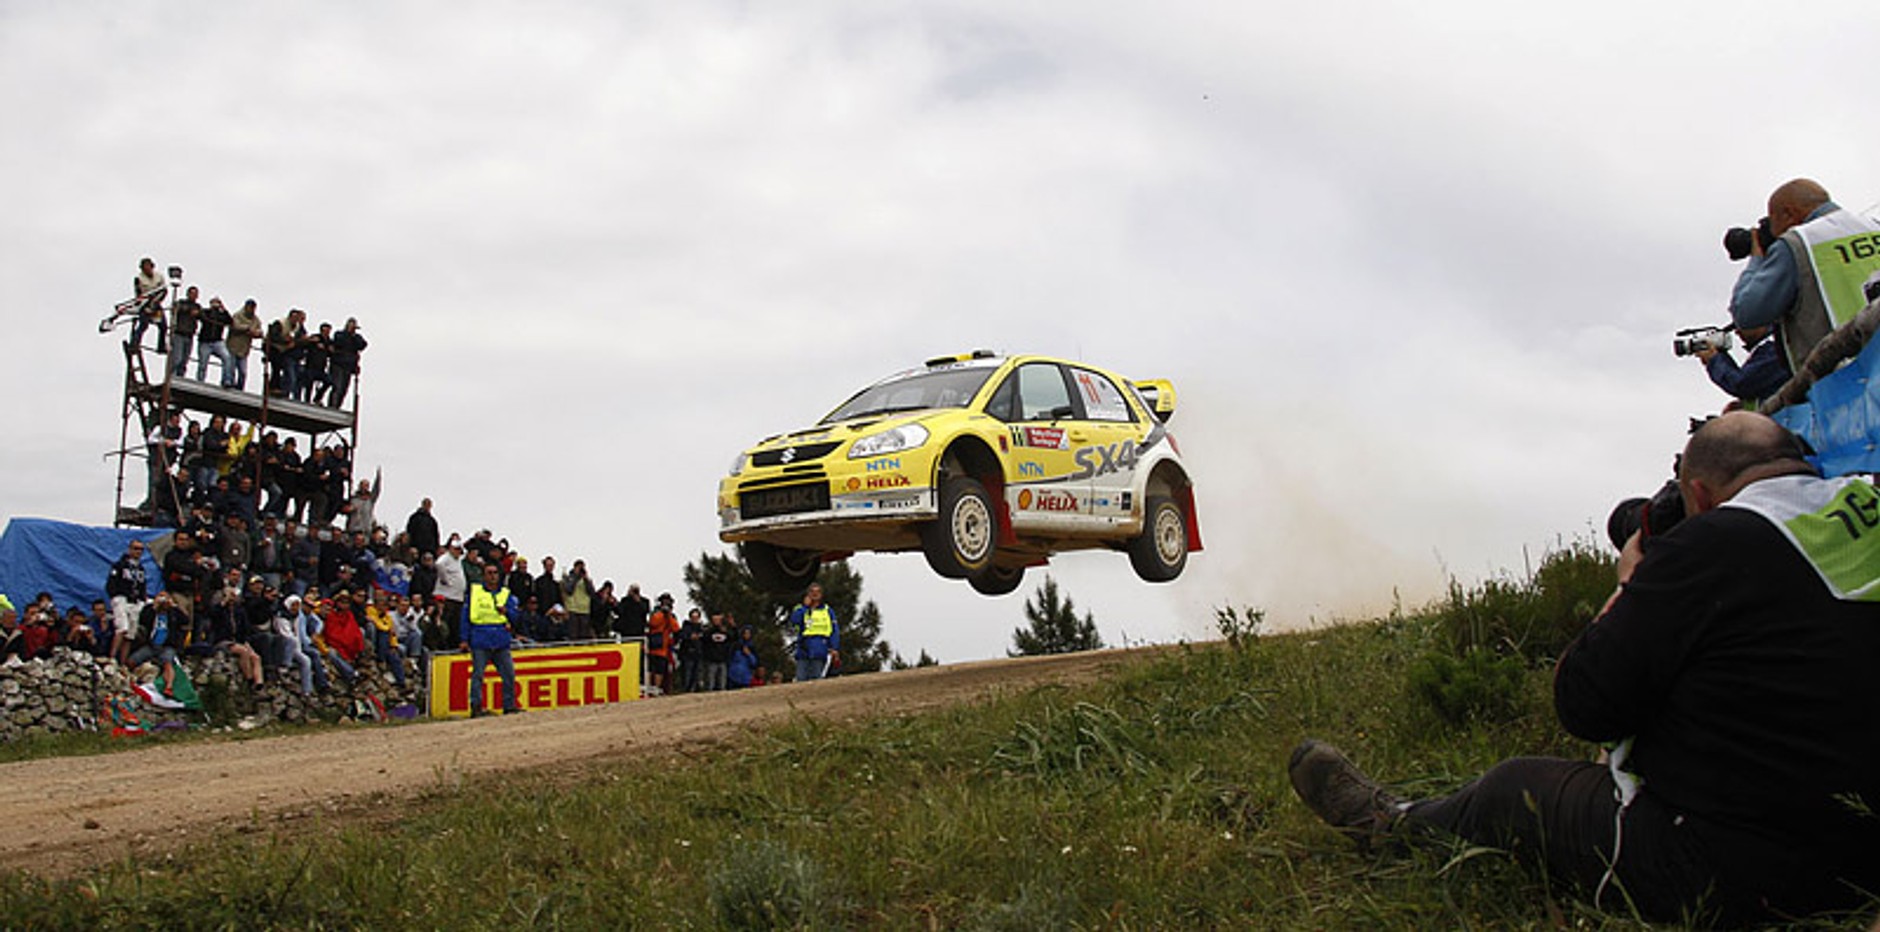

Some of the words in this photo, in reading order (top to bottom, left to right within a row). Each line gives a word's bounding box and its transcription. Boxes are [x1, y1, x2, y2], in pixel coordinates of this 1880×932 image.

[866, 458, 900, 471] NTN
[1070, 438, 1138, 481] SX4
[1018, 462, 1044, 476] NTN
[867, 475, 911, 488] HELIX
[1036, 494, 1078, 511] HELIX
